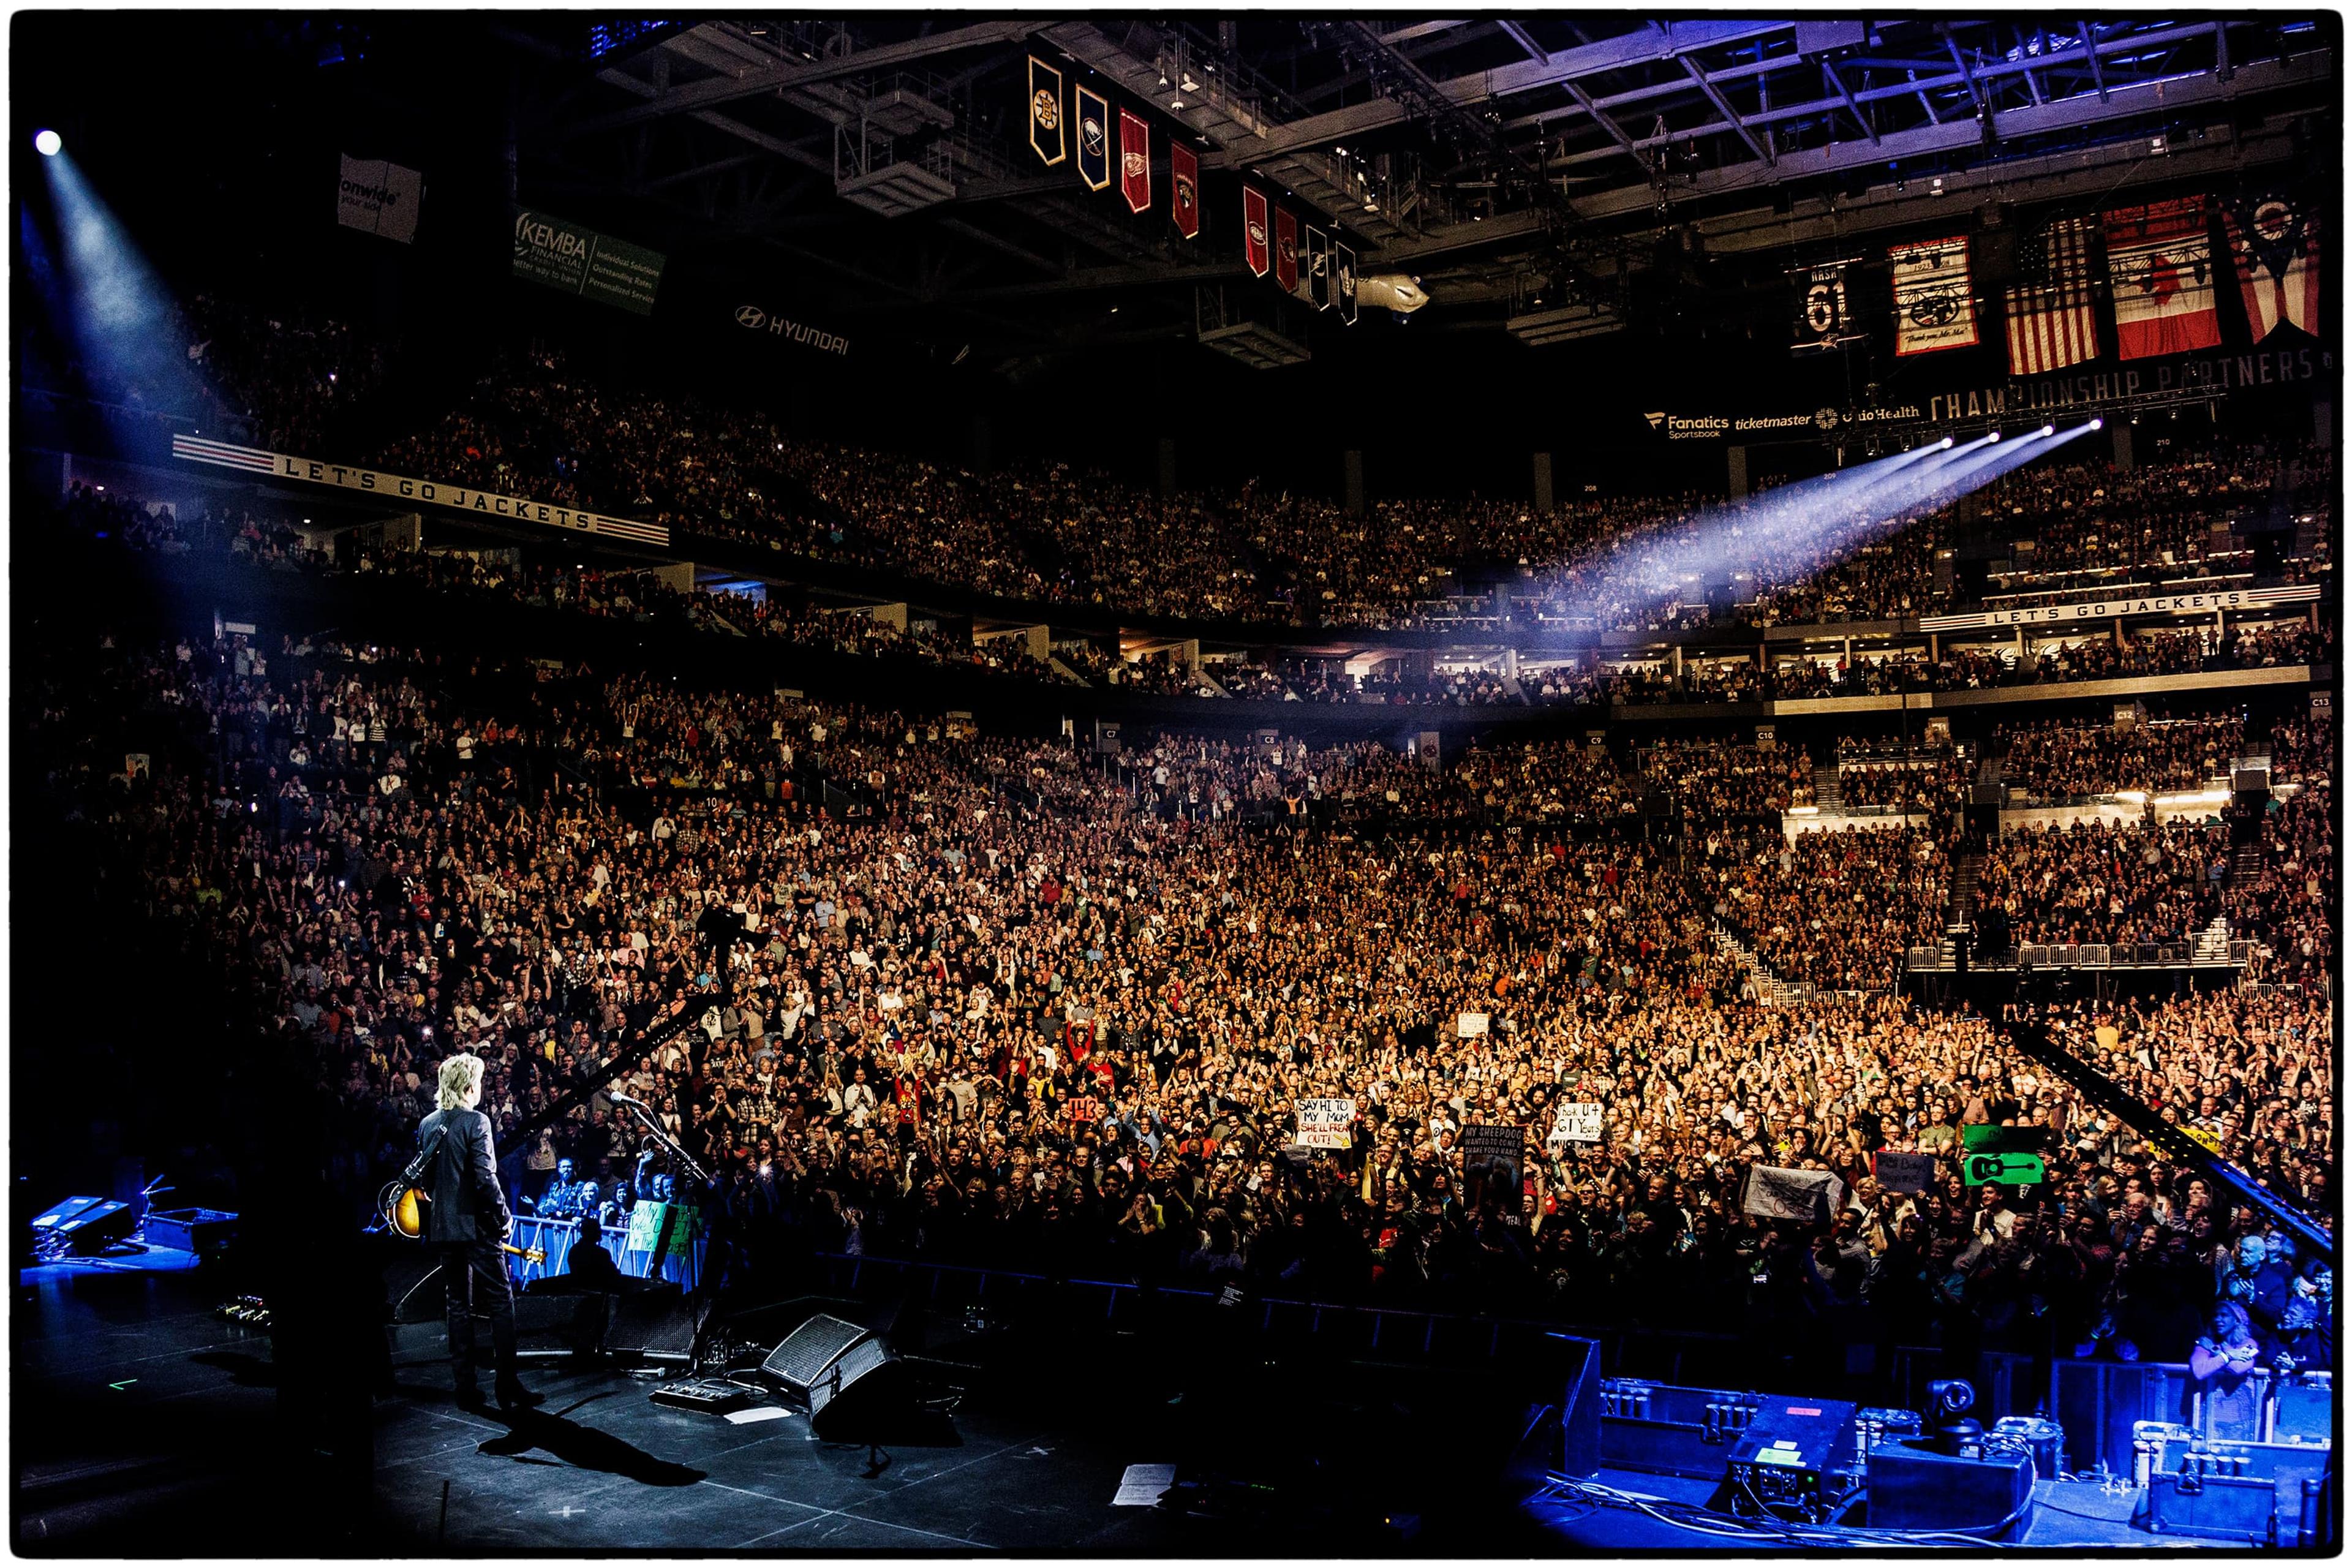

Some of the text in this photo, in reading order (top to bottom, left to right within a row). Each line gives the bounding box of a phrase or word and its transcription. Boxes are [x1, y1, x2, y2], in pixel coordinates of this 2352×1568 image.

[522, 219, 586, 260] KEMBA
[530, 246, 582, 269] FINANCIAL
[1811, 268, 1837, 282] NASH
[1807, 281, 1850, 333] 61
[769, 315, 850, 356] HYUNDAI
[1931, 370, 2139, 421] CHAMIONSHIP
[1668, 415, 1729, 430] Fanatics
[1735, 413, 1812, 431] ticketmaster
[1668, 430, 1721, 440] Sportsbook
[286, 459, 588, 529] LET'S GO JACKETS
[1994, 593, 2239, 624] LET'S GO JACKETS
[1107, 729, 1117, 739] C7
[1071, 1100, 1096, 1119] 143
[1298, 1099, 1348, 1112] SAY HI TO
[1304, 1112, 1319, 1122] MY
[1301, 1123, 1349, 1133] SHE'LL FREA
[1464, 1127, 1522, 1140] MY SHEEPDOG
[1558, 1118, 1600, 1134] 61 Years
[1307, 1134, 1330, 1145] OUT!
[1464, 1137, 1490, 1146] WANTED
[636, 1202, 658, 1223] Why
